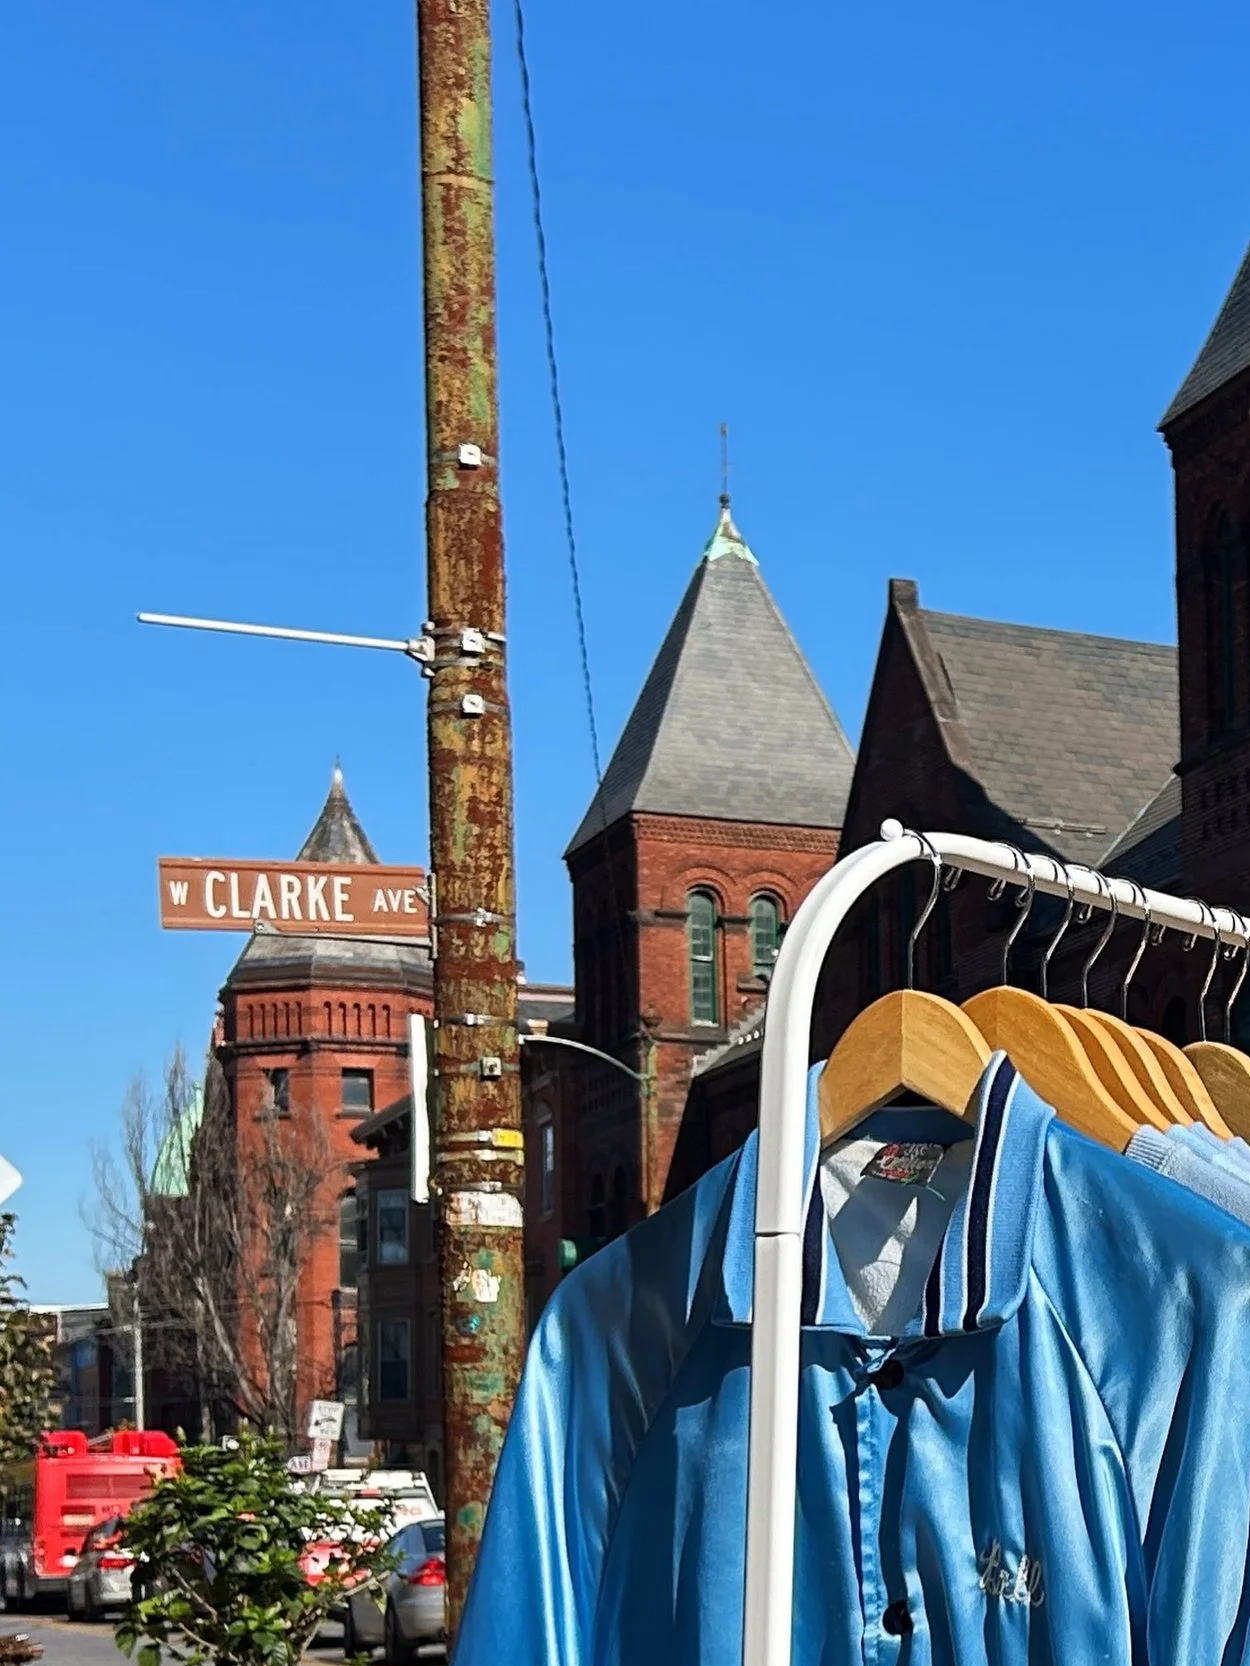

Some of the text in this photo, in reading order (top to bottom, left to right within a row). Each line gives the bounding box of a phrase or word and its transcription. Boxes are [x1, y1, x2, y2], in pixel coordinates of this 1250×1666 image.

[169, 870, 418, 923] W CLARKE AVE
